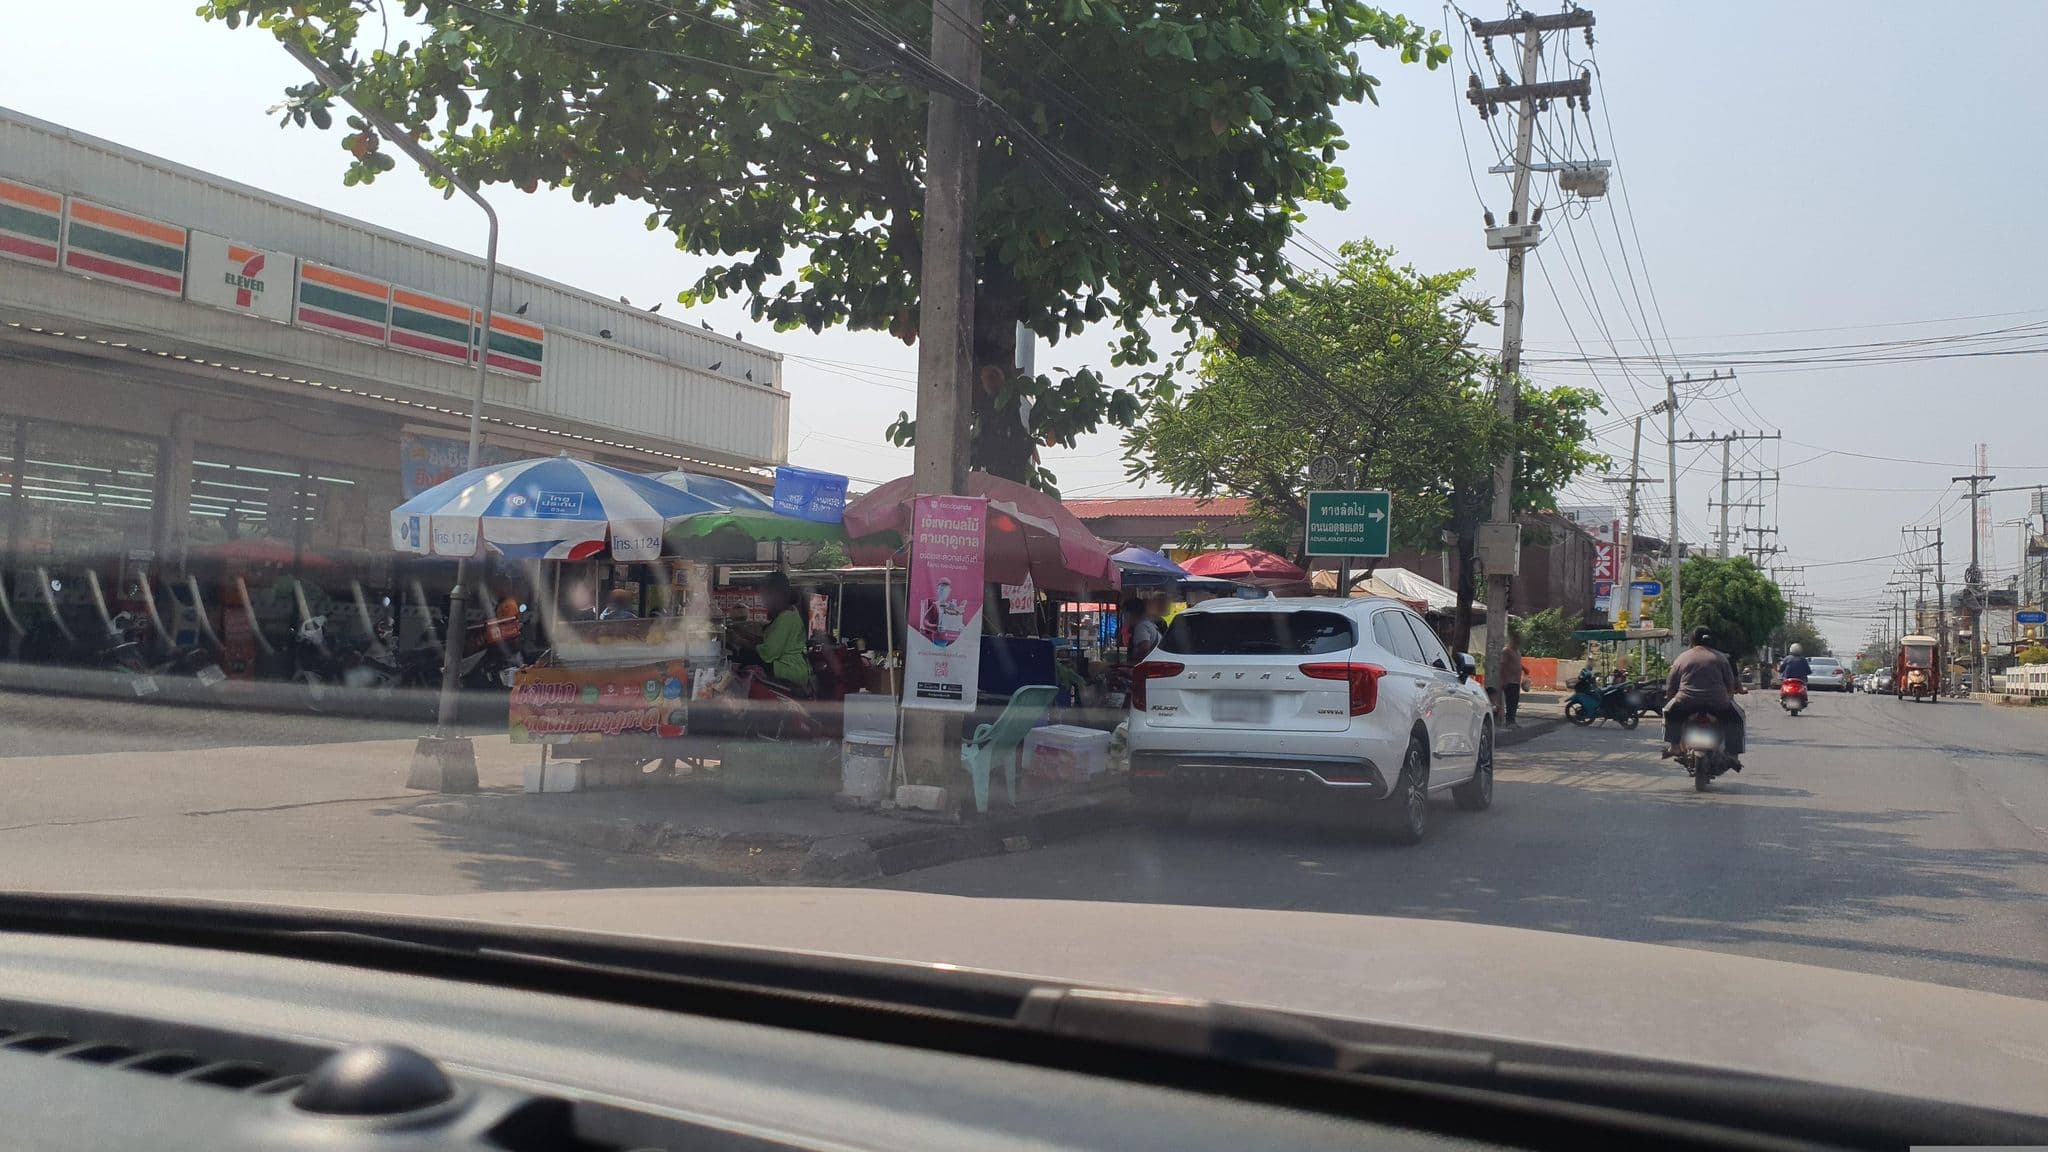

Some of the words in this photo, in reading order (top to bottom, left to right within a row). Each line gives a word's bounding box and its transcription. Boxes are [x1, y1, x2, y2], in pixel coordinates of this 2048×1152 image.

[1320, 502, 1365, 516] ทางลัดไป
[1311, 522, 1364, 536] ถนนอดุลยเดช
[613, 536, 660, 551] โทร.1124
[920, 533, 979, 549] ตามฤดูกาล
[1188, 671, 1295, 680] HAVAL
